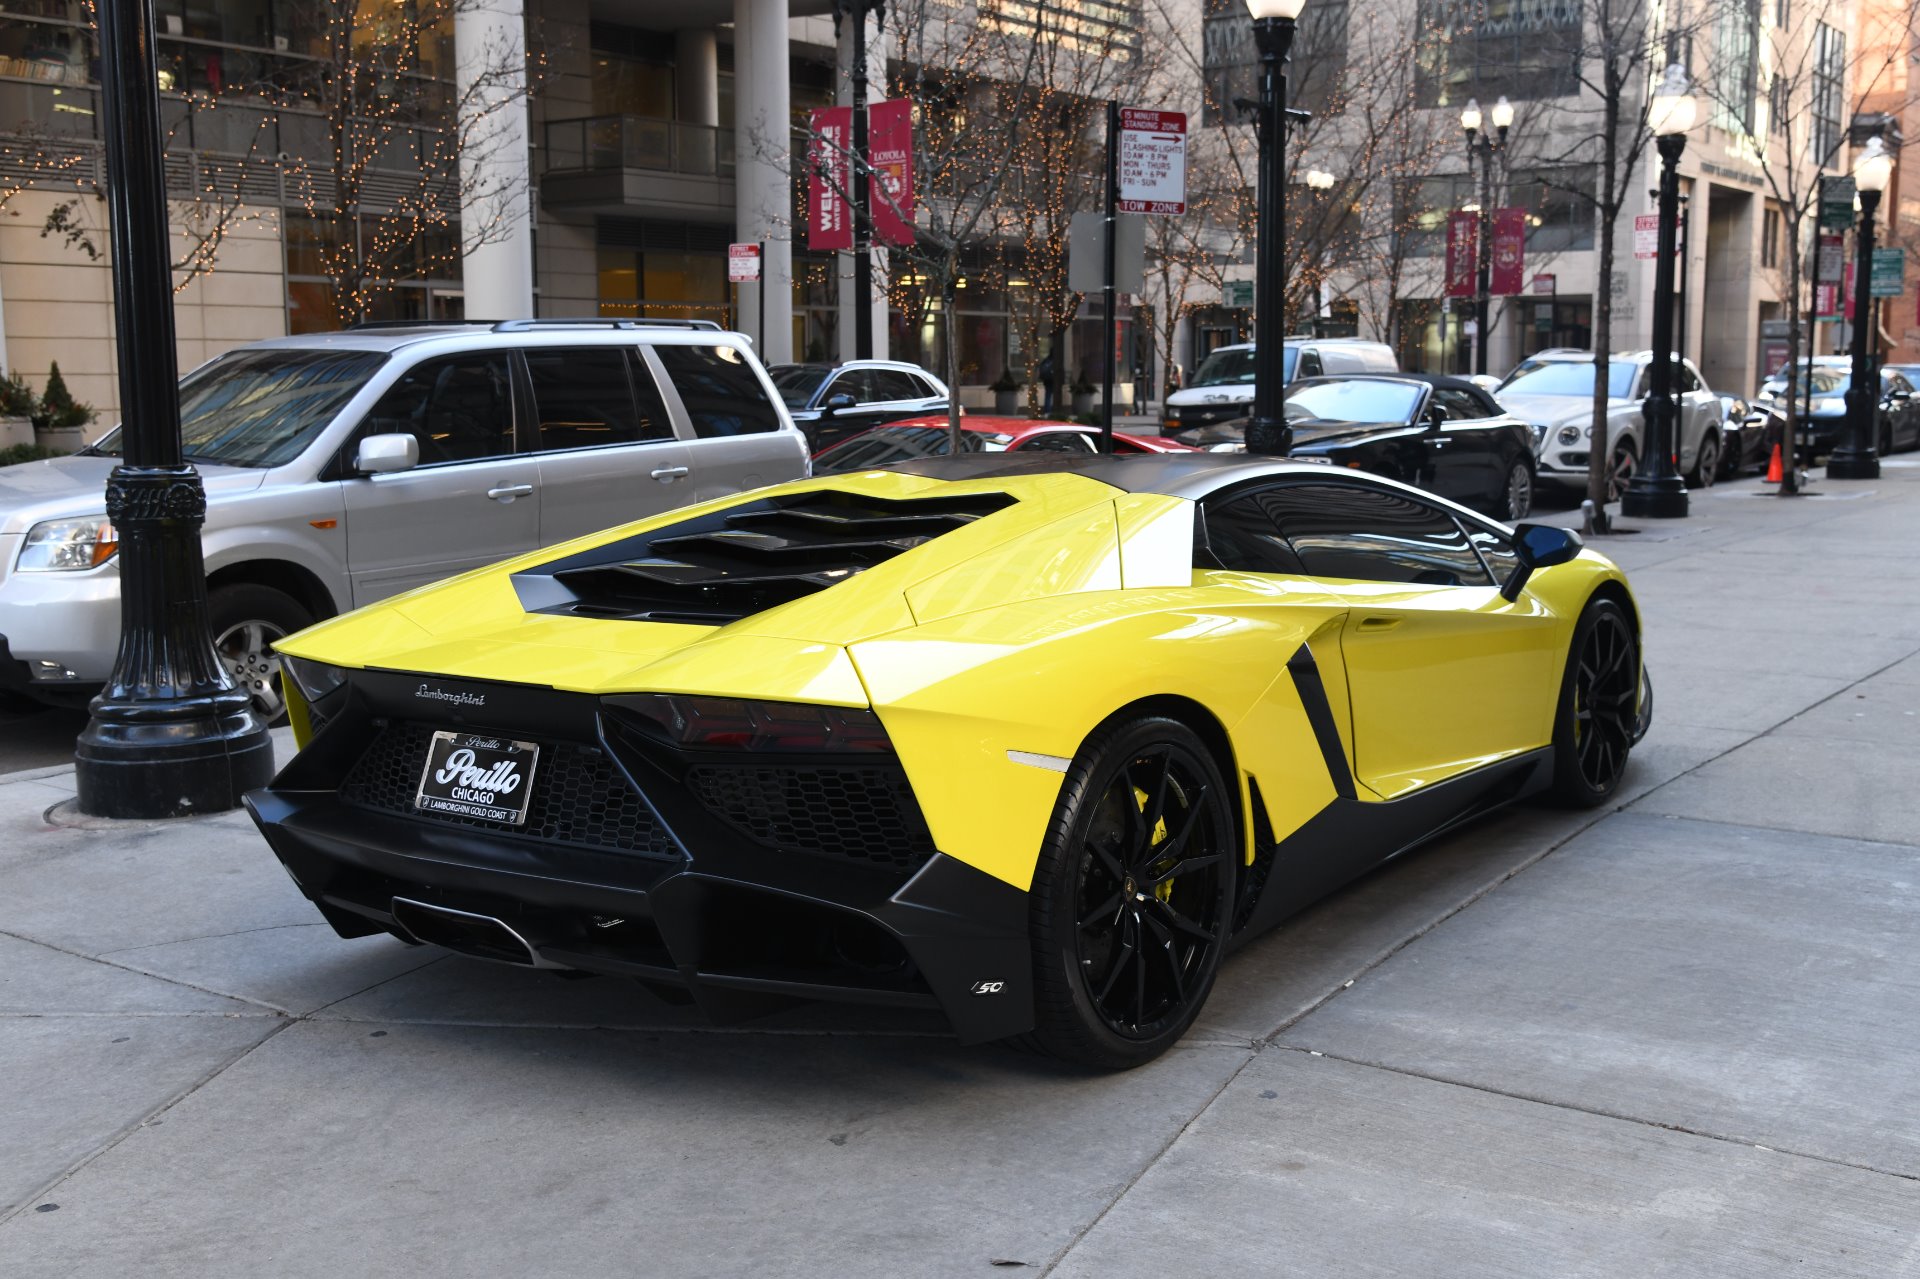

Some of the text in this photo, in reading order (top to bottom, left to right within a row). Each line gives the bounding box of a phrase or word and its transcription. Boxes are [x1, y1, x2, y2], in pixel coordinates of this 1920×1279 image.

[1134, 112, 1159, 120] MINUTE
[1124, 121, 1179, 131] STANDING ZONE
[1123, 134, 1138, 142] USE
[1123, 143, 1183, 154] FLASHING LIGHTS
[874, 150, 906, 161] LOYOLA
[1132, 152, 1144, 160] AM
[1157, 153, 1168, 161] PM
[1147, 161, 1171, 170] THURS
[1132, 169, 1143, 177] AM
[1141, 178, 1157, 187] SUN
[1123, 201, 1179, 213] TOW ZONE
[415, 684, 486, 706] Lamborghini
[466, 736, 500, 749] Perillo
[435, 749, 521, 794] Perillo
[451, 787, 494, 804] CHICAGO
[430, 800, 507, 820] LAMBORGHINI GOLD COAST
[976, 981, 1003, 993] 50
